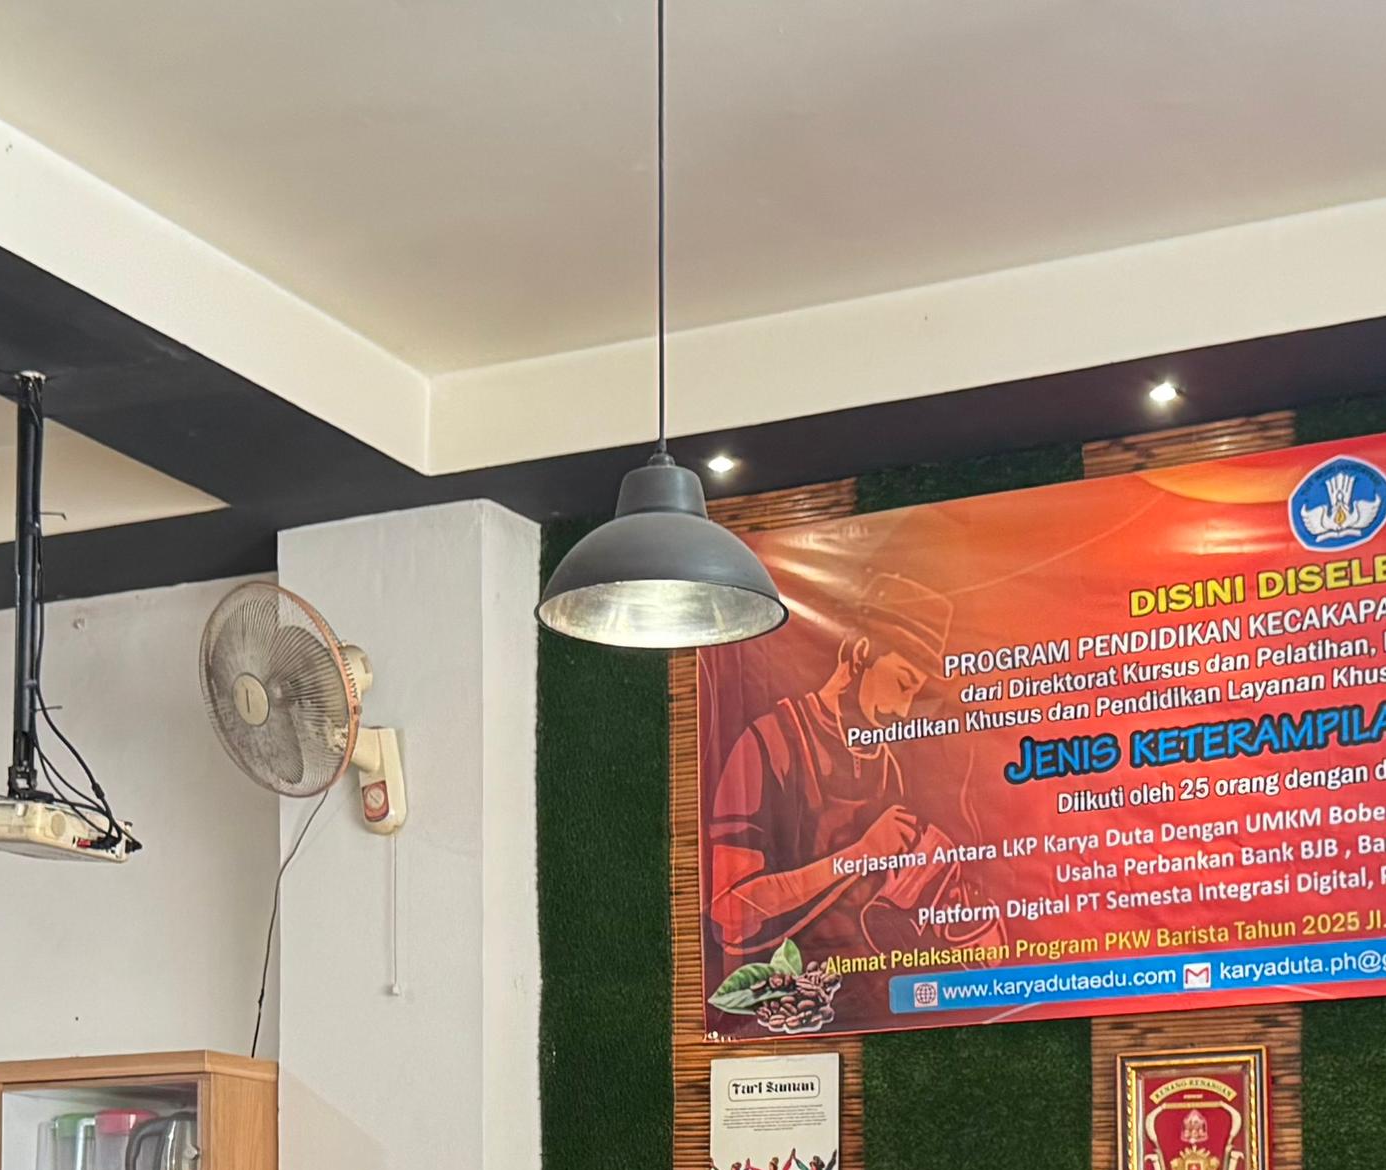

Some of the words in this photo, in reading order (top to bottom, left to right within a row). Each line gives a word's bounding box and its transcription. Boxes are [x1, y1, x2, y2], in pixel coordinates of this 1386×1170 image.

[1130, 575, 1244, 616] DISINI
[944, 639, 1070, 677] PROGRAM
[1078, 617, 1240, 659] PENDIDIKAN
[960, 681, 1002, 703] dari
[1009, 667, 1118, 698] Direktorat
[1123, 660, 1200, 684] Kursus
[1205, 653, 1250, 673] dan
[1257, 638, 1376, 668] Pelatihan,
[848, 718, 960, 747] Pendidikan
[965, 708, 1042, 732] Khusus
[1047, 702, 1089, 721] dan
[1096, 686, 1221, 717] Pendidikan
[1228, 674, 1325, 702] Layanan
[1058, 786, 1124, 813] Diikuti
[1129, 782, 1174, 805] oleh
[1180, 777, 1209, 800] 25
[1215, 772, 1280, 796] orang
[1284, 765, 1368, 790] dengan
[833, 851, 927, 877] Kerjasama
[932, 844, 997, 865] Antara
[1003, 836, 1038, 858] LKP
[1044, 834, 1099, 854] Karya
[1105, 827, 1154, 847] Duta
[1161, 819, 1239, 843] Dengan
[1245, 807, 1322, 833] UMKM
[1056, 860, 1118, 883] Usaha
[1124, 850, 1234, 877] Perbankan
[1241, 841, 1294, 866] Bank
[1300, 838, 1339, 860] BJB
[918, 902, 1001, 926] Platform
[1006, 894, 1070, 921] Digital
[1076, 892, 1101, 913] PT
[1106, 886, 1193, 910] Semesta
[1198, 874, 1290, 902] Integrasi
[1296, 866, 1374, 895] Digital,
[824, 953, 887, 977] Alamat
[890, 944, 1010, 969] Pelaksanaan
[1016, 937, 1098, 960] Program
[1104, 929, 1151, 952] PKW
[1156, 925, 1230, 948] Barista
[1233, 920, 1296, 941] Tahun
[1302, 911, 1360, 935] 2025
[942, 970, 1176, 999] www.karyadutaedu.com
